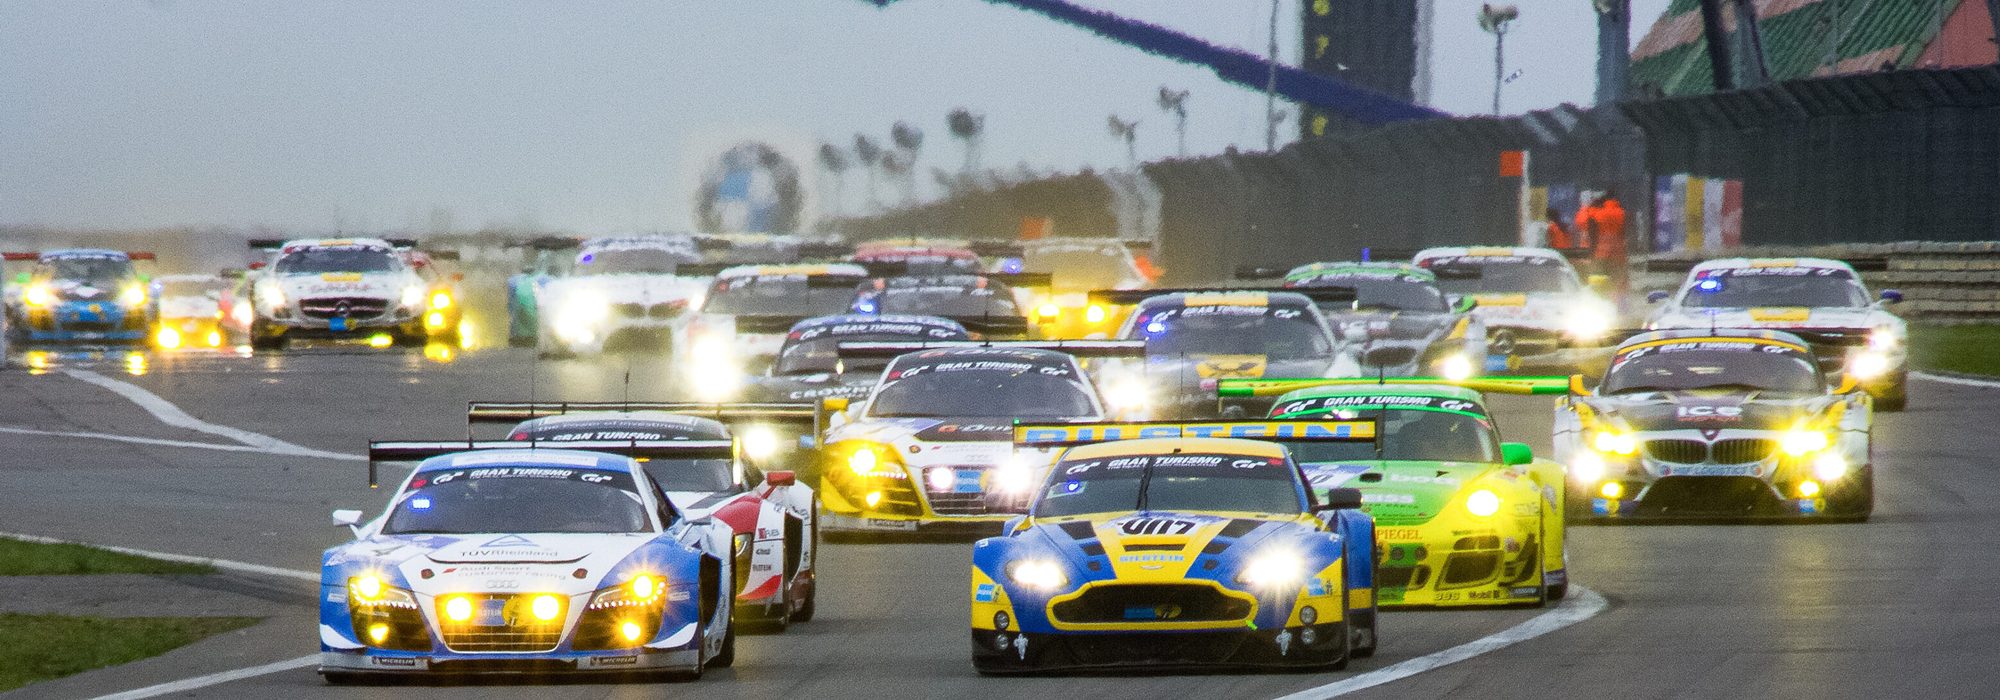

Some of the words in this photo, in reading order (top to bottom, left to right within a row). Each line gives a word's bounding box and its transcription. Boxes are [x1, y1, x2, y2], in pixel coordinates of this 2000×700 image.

[936, 362, 973, 373] GRAN
[974, 361, 1032, 371] TURISMO
[1284, 399, 1316, 414] GT
[1323, 397, 1365, 407] GRAN
[1368, 396, 1432, 405] TURISMO
[1440, 400, 1474, 411] GT
[552, 433, 592, 441] GRAN
[596, 431, 661, 440] TURISMO
[1108, 457, 1149, 468] GRAN
[1155, 456, 1223, 467] TURISMO
[1232, 459, 1267, 469] GT
[1066, 461, 1101, 475] GT
[432, 471, 465, 485] GT
[470, 470, 509, 479] GRAN
[512, 469, 573, 478] TURISMO
[581, 473, 613, 483] GT
[1375, 528, 1423, 540] PIEGEL
